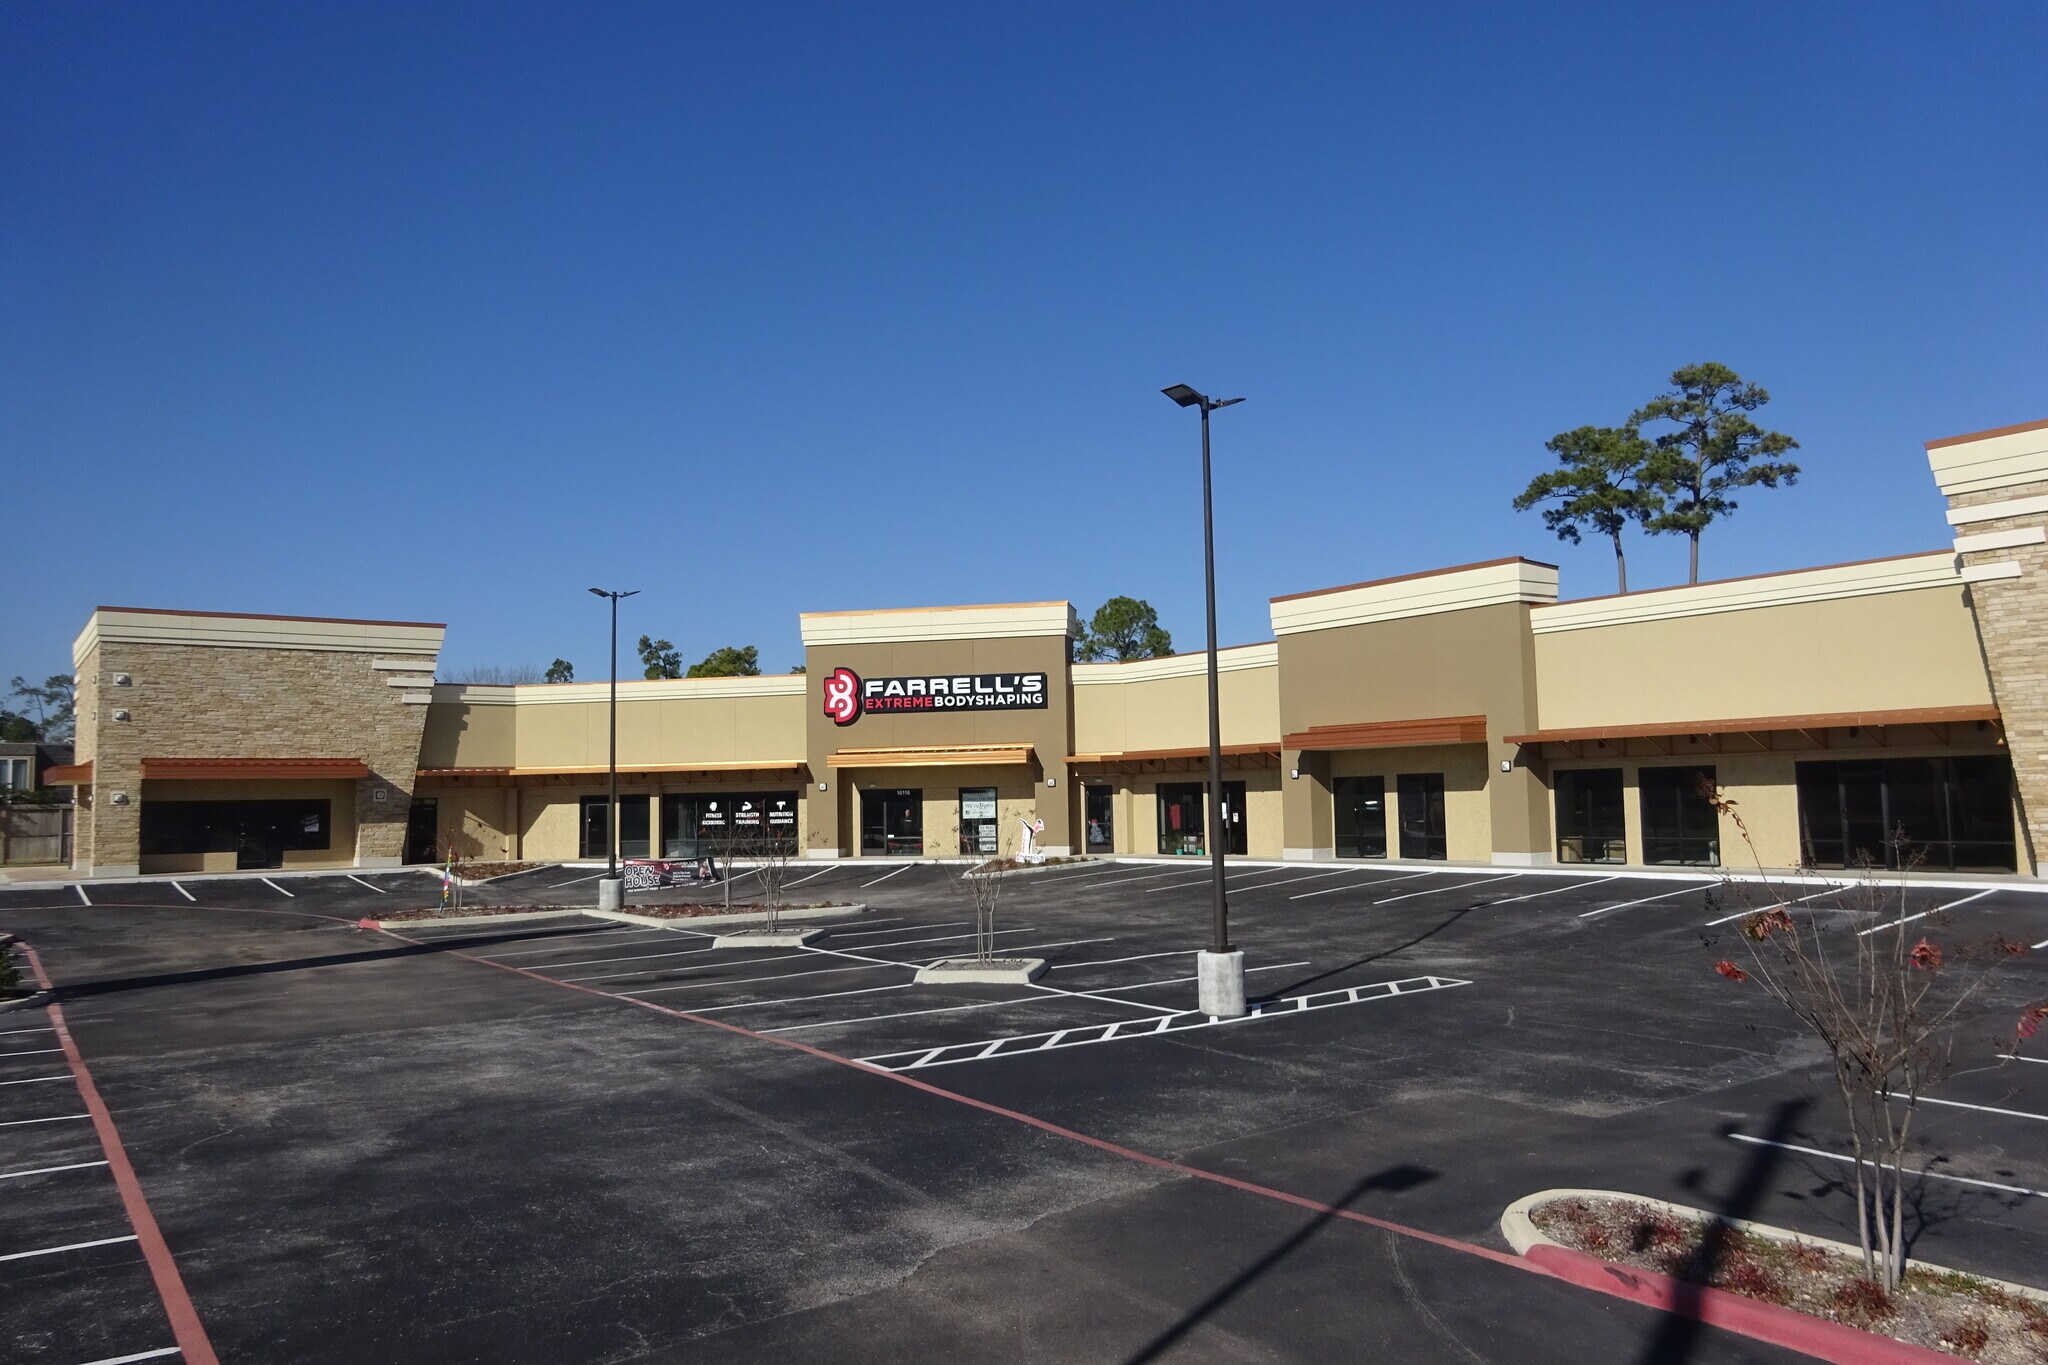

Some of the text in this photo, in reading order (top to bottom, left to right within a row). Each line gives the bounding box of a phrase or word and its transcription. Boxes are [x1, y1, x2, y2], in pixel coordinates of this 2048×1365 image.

[866, 675, 1042, 697] FARRELL'S
[866, 693, 1043, 709] EXTREME BODYSHAPING
[624, 865, 655, 877] OPEN
[624, 875, 661, 889] HOUSE
